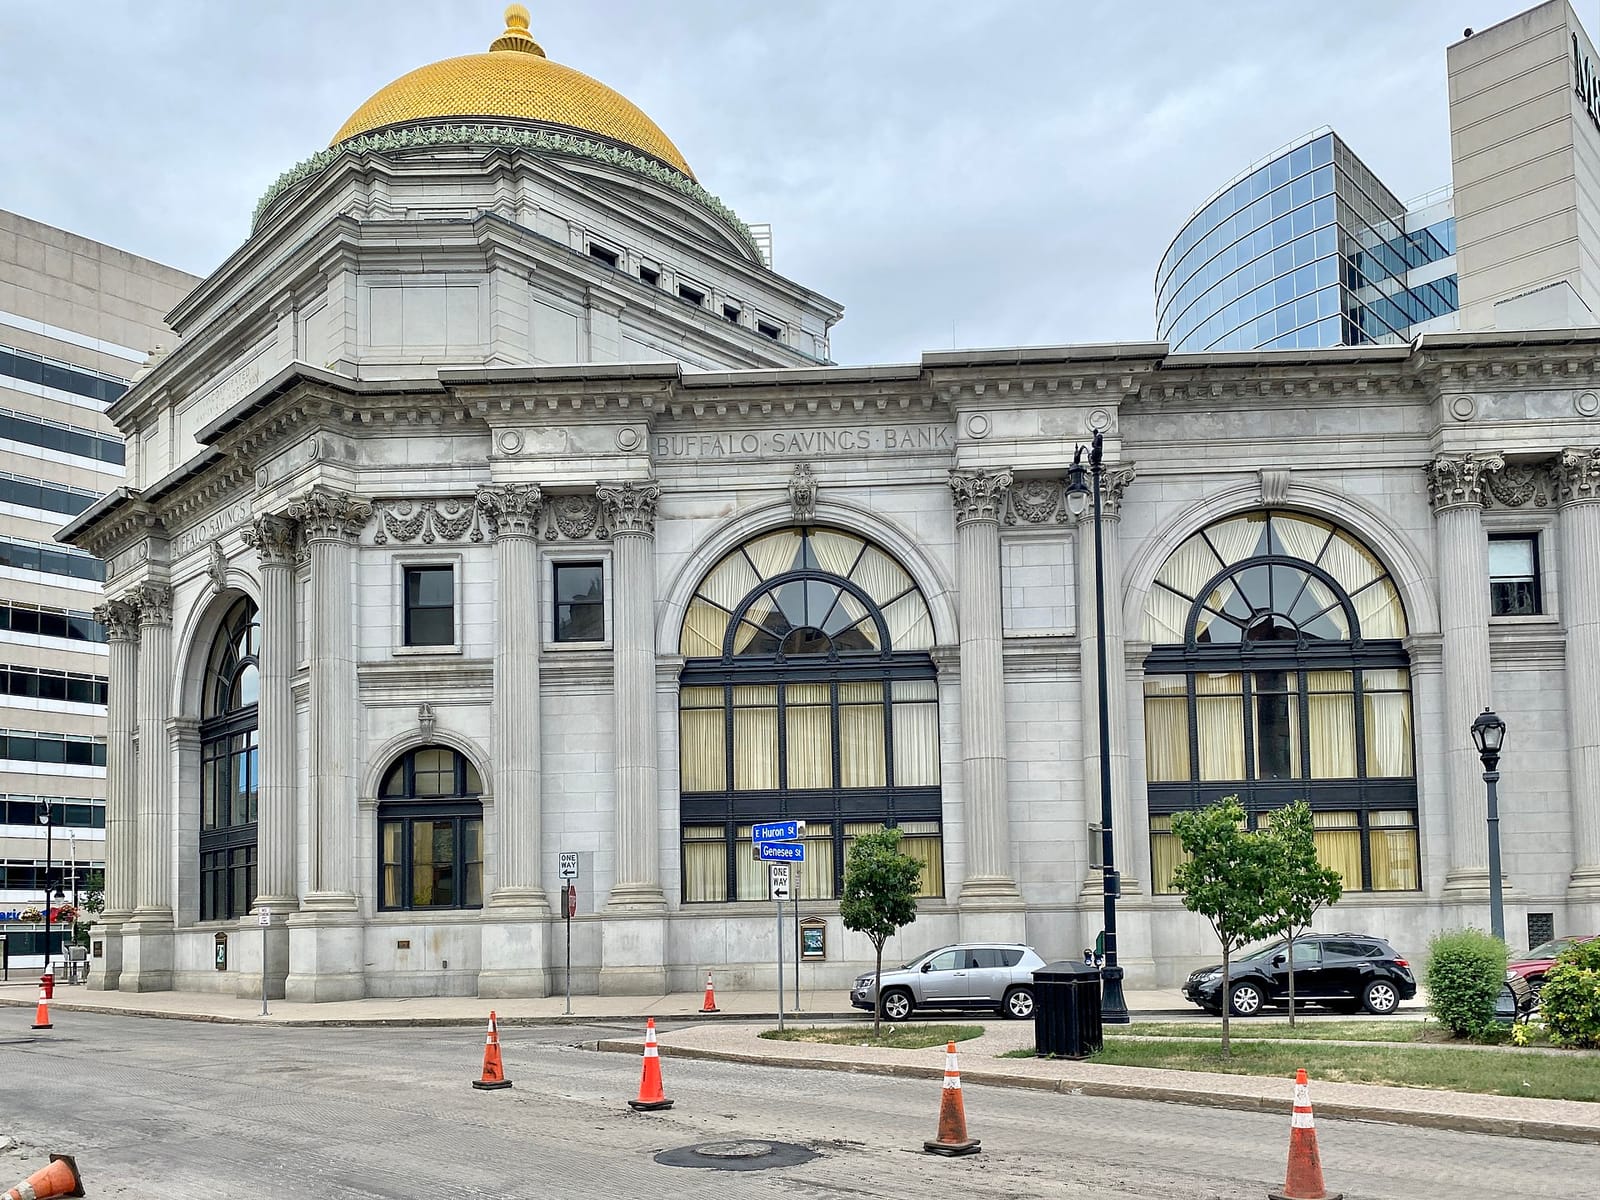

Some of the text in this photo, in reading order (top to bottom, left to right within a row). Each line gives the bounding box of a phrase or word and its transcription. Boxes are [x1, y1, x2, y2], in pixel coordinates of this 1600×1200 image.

[655, 426, 950, 457] BUFFALO SAVINGS BANK
[169, 501, 246, 560] BUFFALO SAVINGS
[755, 826, 794, 838] E Huron St
[763, 845, 801, 858] Genesee St
[773, 867, 788, 877] ONE
[773, 877, 788, 887] WAY
